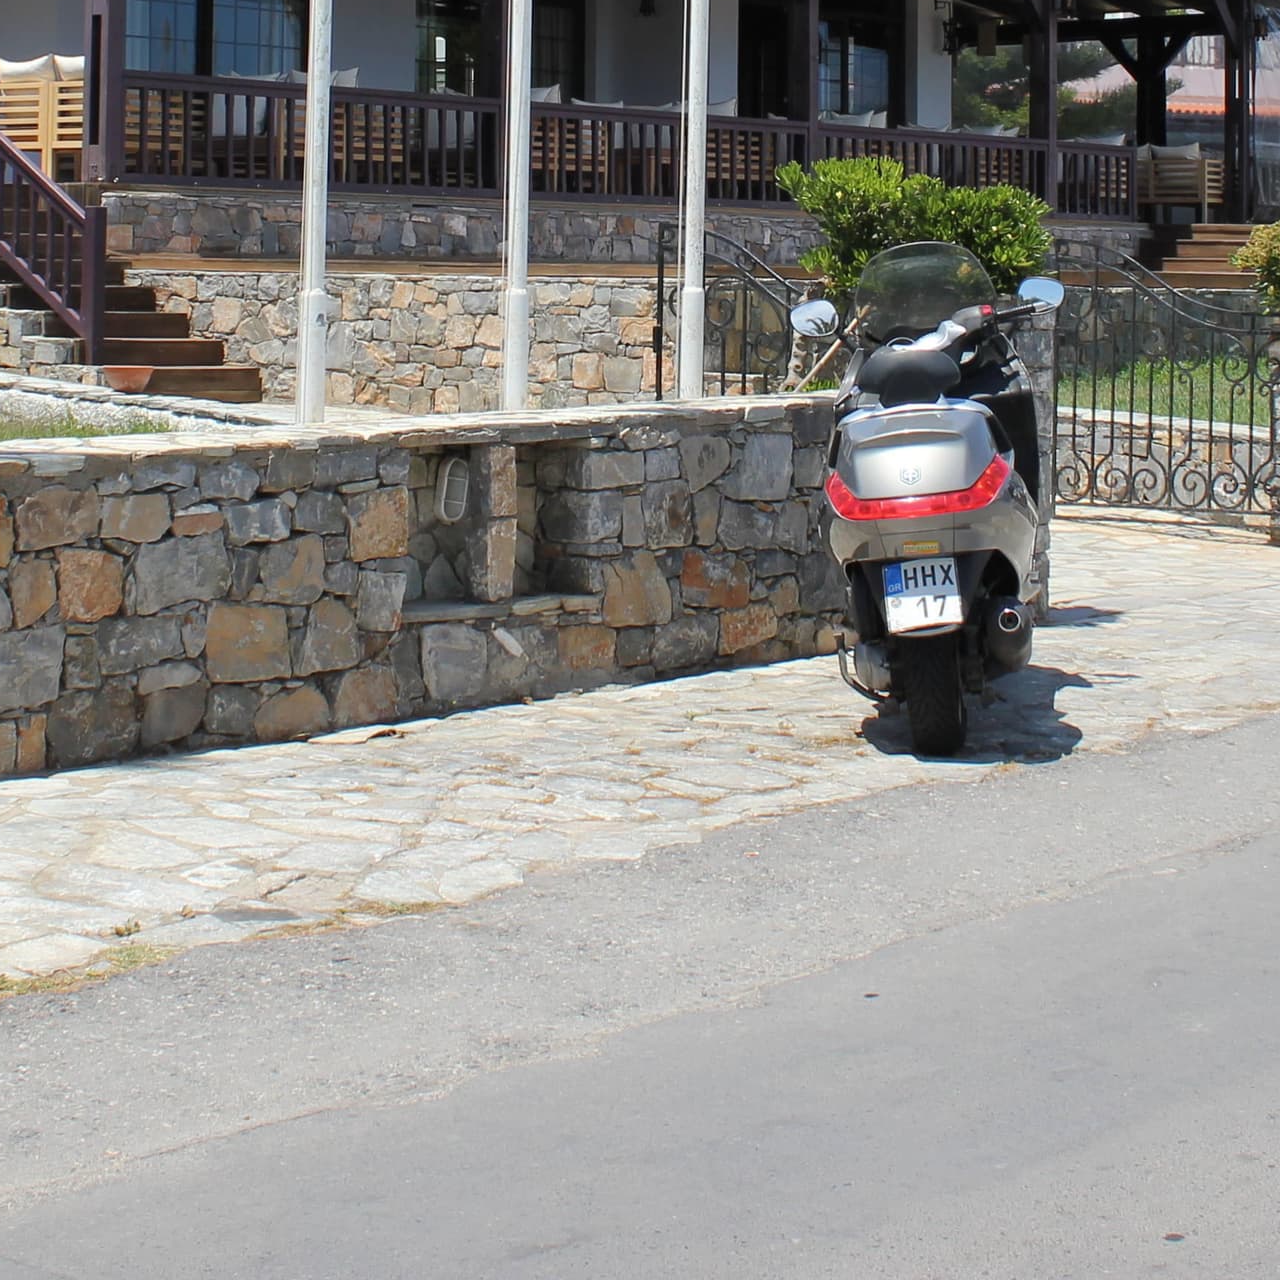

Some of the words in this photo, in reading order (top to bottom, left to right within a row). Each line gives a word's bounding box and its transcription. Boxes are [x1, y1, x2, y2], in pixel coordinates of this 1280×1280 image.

[888, 583, 902, 593] GR
[904, 564, 954, 590] HHX
[916, 595, 946, 618] 17
